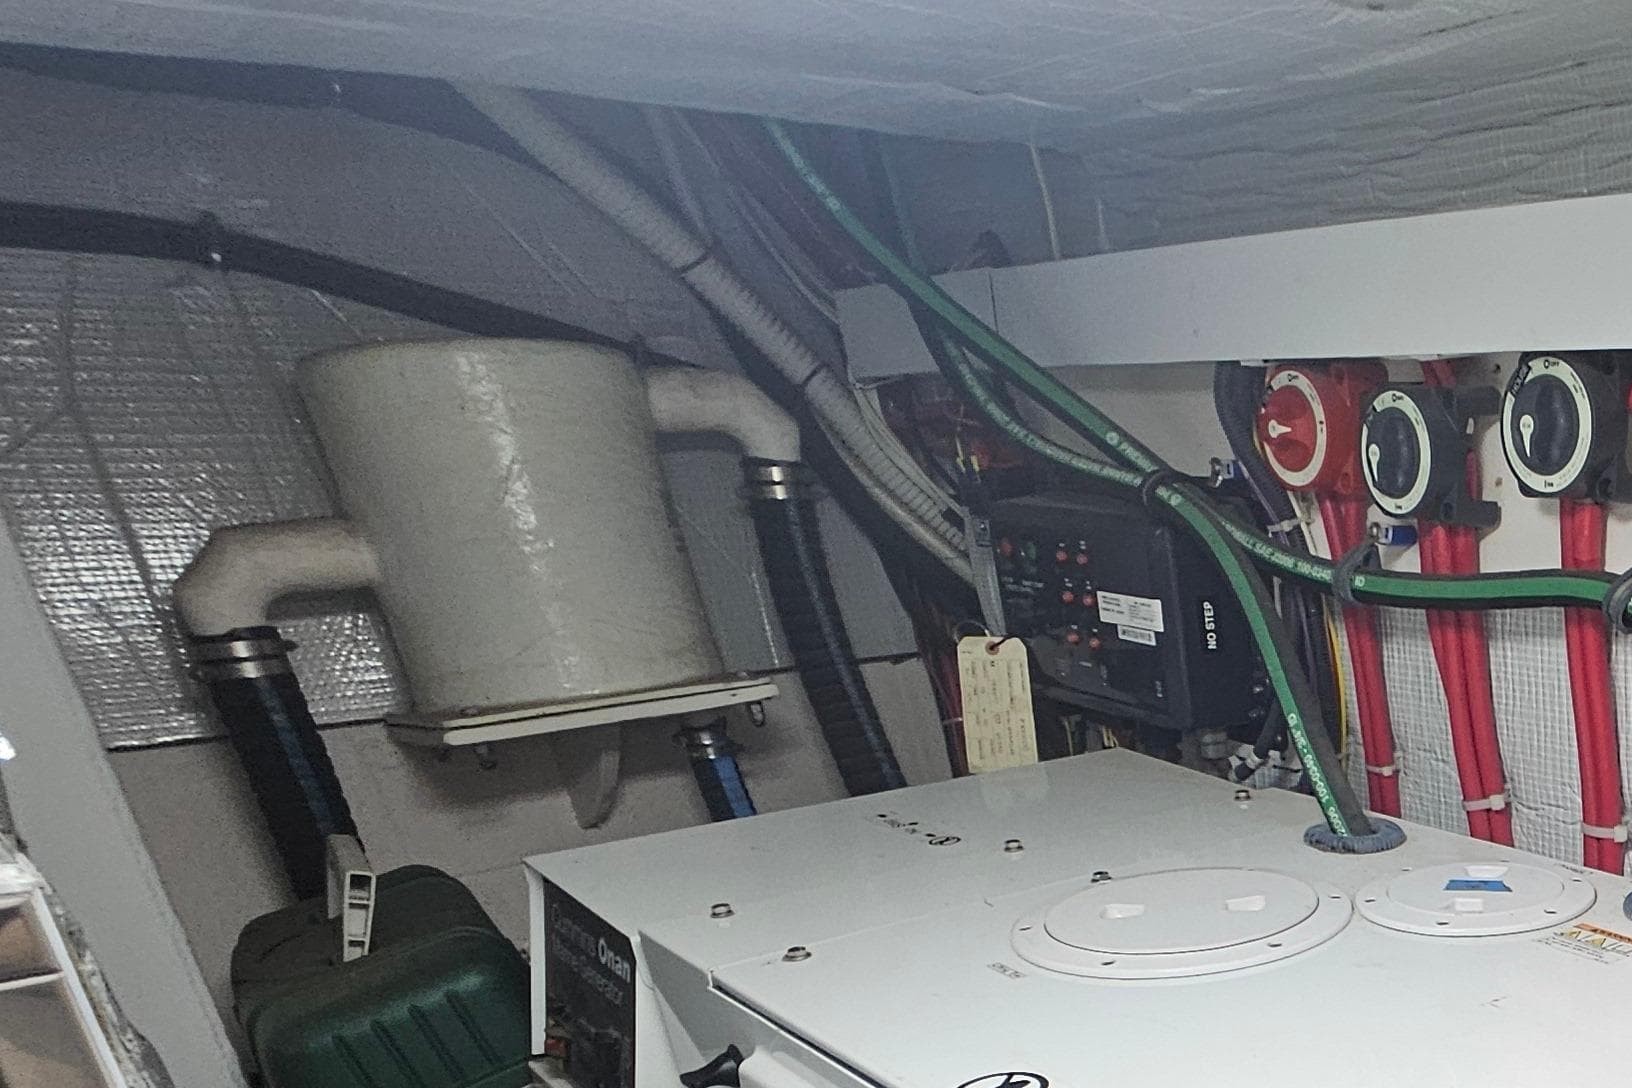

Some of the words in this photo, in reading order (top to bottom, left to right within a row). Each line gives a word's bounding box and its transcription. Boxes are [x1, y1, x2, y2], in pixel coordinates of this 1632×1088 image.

[1203, 600, 1215, 632] STEP
[1205, 632, 1217, 650] NO
[597, 936, 631, 984] Onan
